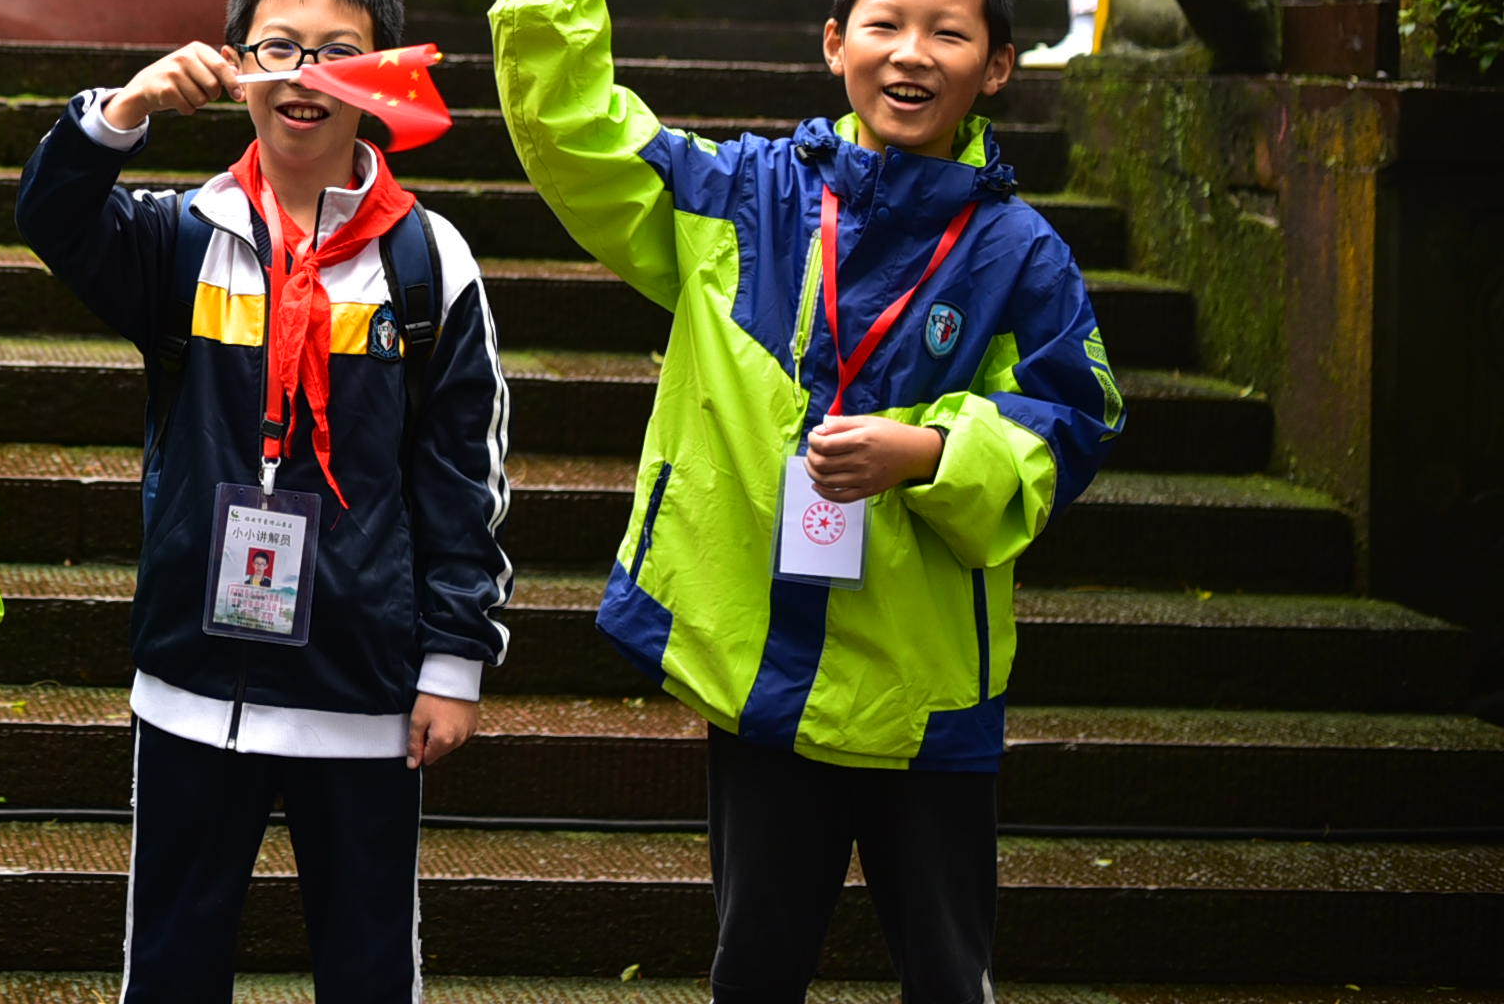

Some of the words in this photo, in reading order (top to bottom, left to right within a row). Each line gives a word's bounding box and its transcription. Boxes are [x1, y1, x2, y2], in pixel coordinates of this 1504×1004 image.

[232, 526, 292, 547] 小小讲解员
